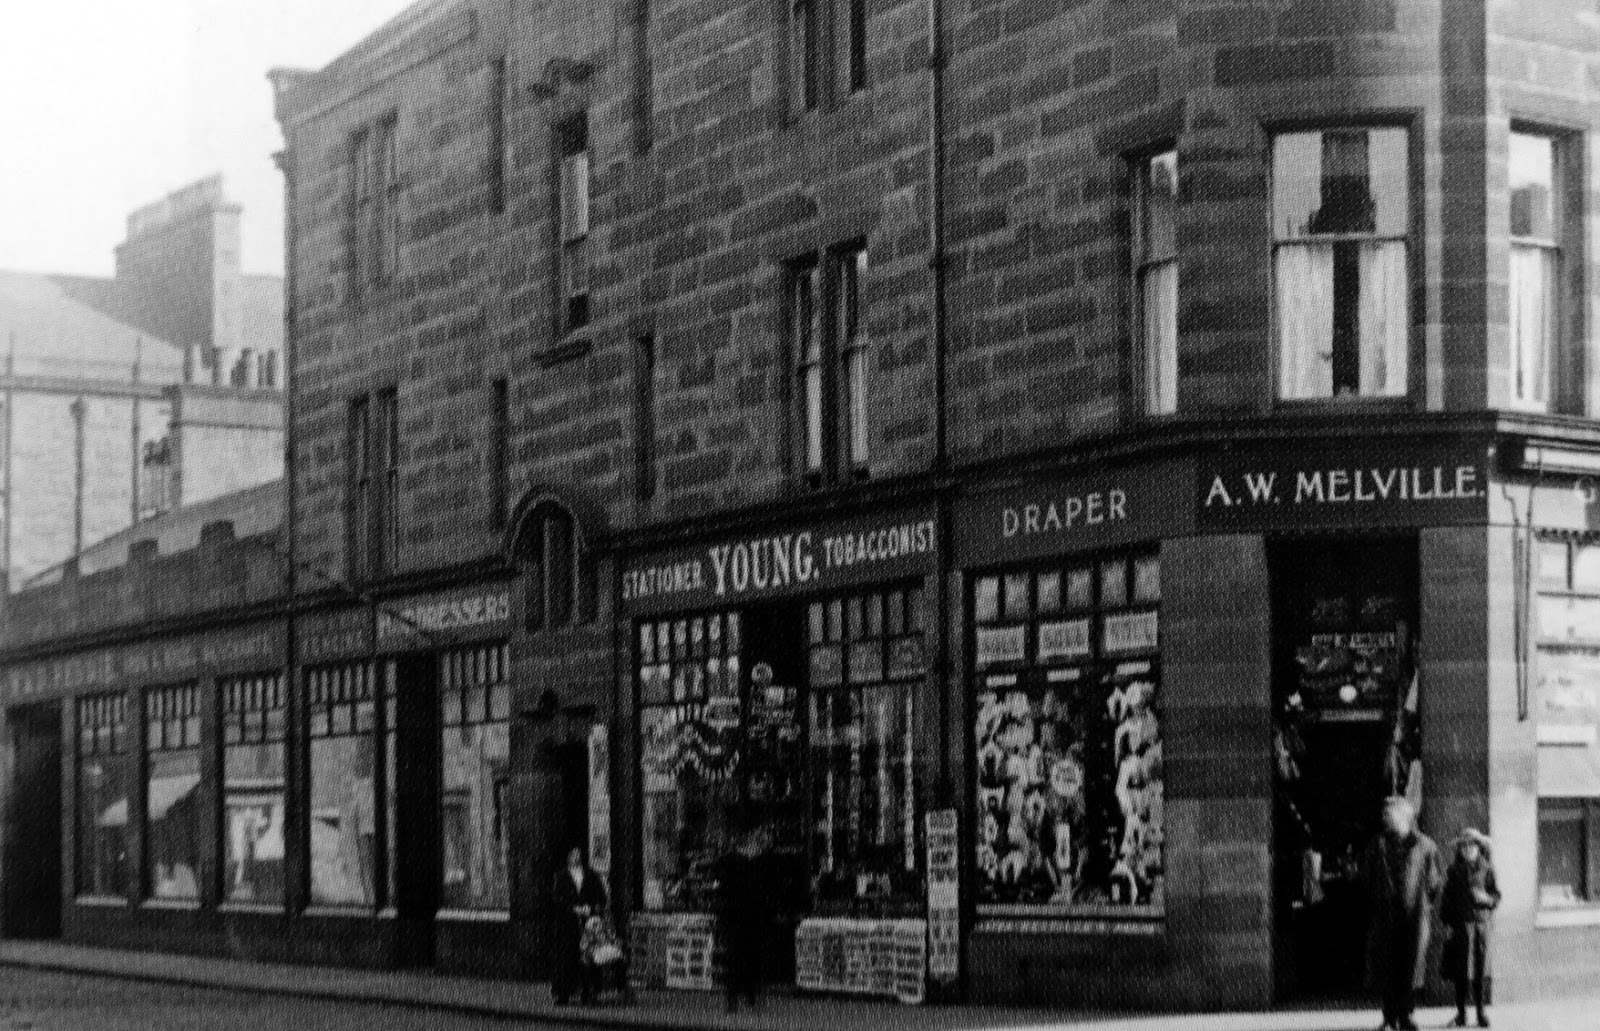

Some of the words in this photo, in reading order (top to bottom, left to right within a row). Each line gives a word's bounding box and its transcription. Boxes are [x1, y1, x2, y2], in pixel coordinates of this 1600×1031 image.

[1294, 466, 1486, 504] MELVILLE.
[1002, 489, 1127, 538] DRAPER
[708, 531, 820, 596] YOUNG.
[823, 520, 935, 568] TOBACCONIST
[377, 593, 511, 639] HDRESSERS
